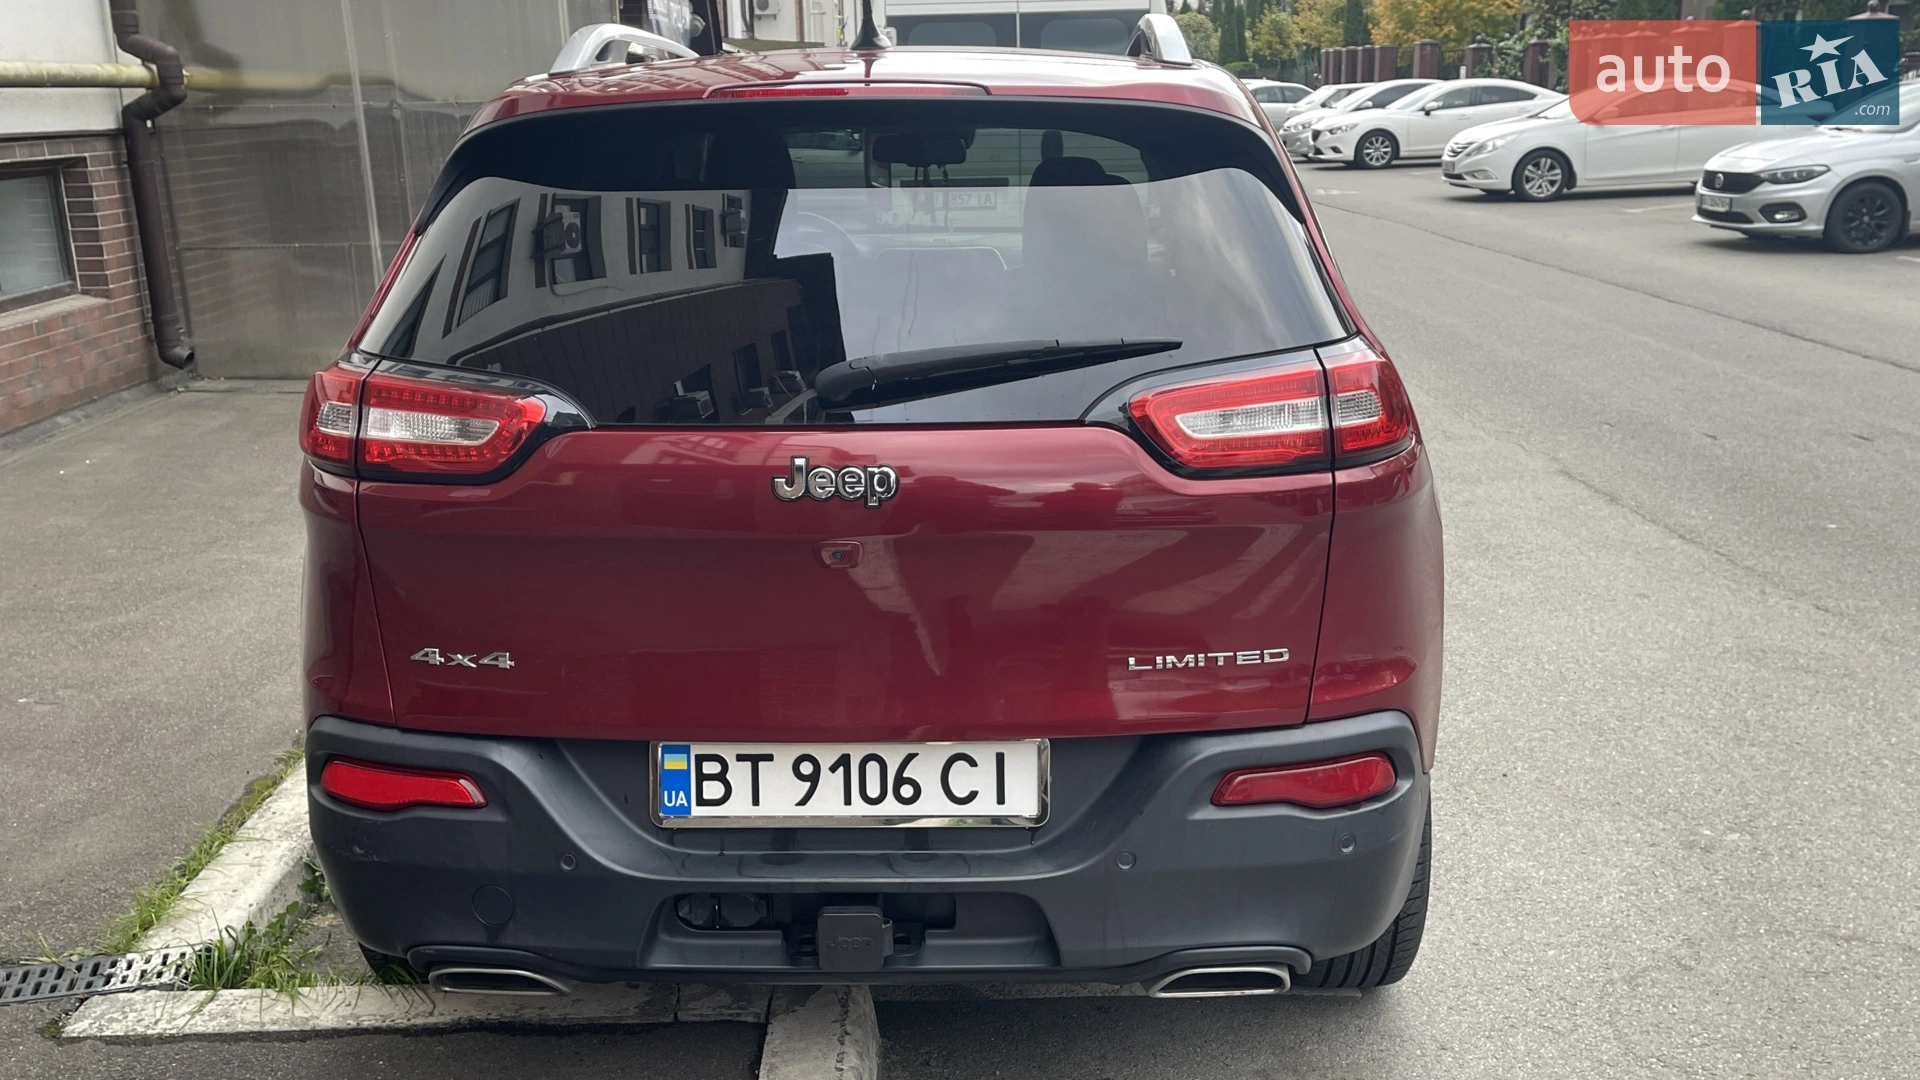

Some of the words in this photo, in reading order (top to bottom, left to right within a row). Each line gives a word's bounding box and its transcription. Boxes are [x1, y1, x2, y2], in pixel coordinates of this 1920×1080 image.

[772, 455, 899, 508] Jeep
[410, 647, 515, 669] 4x4
[1128, 648, 1290, 671] LIMITED
[695, 753, 774, 807] BT
[791, 752, 922, 806] 9106
[940, 751, 1005, 806] CI
[664, 790, 688, 807] UA
